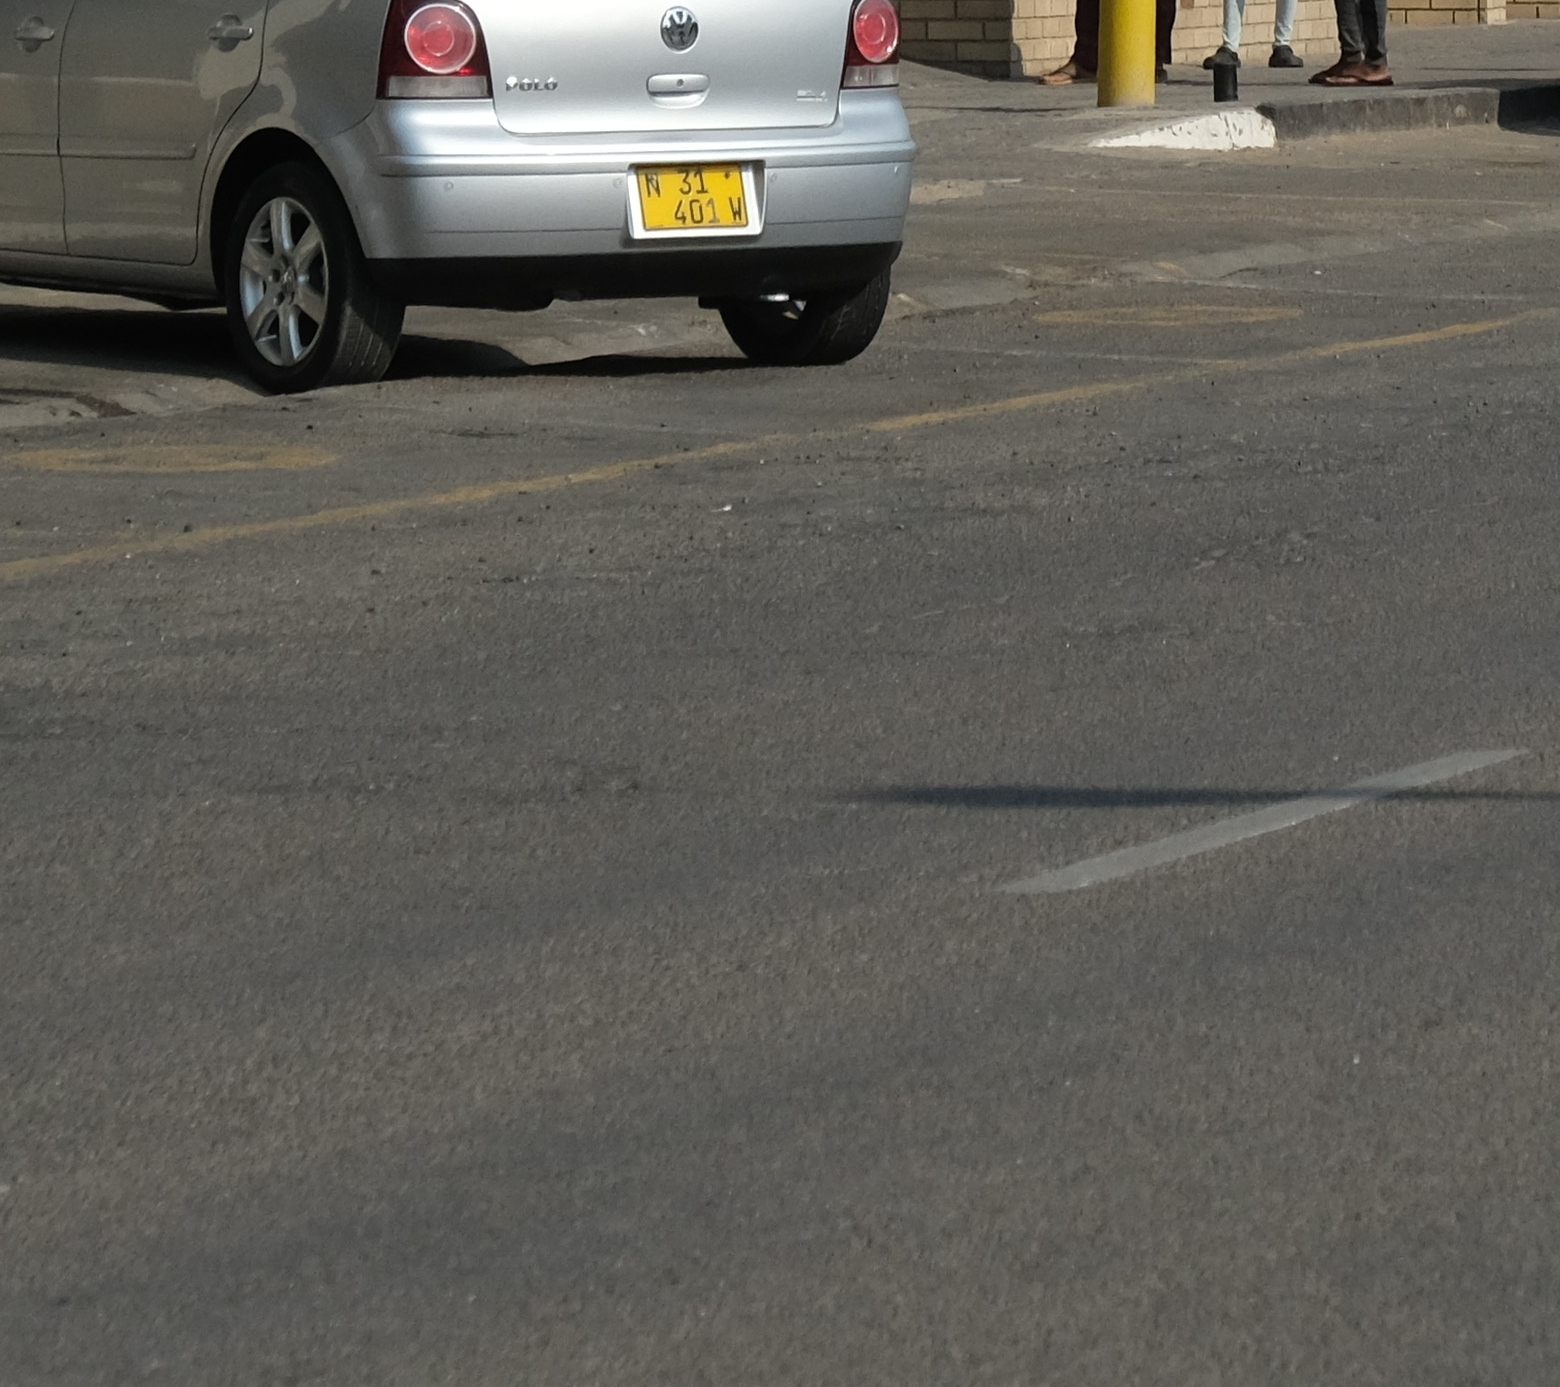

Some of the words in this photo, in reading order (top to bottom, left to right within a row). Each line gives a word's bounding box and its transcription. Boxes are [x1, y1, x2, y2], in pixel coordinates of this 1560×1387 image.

[505, 75, 559, 93] POLO
[645, 173, 661, 199] N
[678, 170, 710, 196] 31
[674, 198, 721, 225] 401
[728, 196, 742, 223] W
